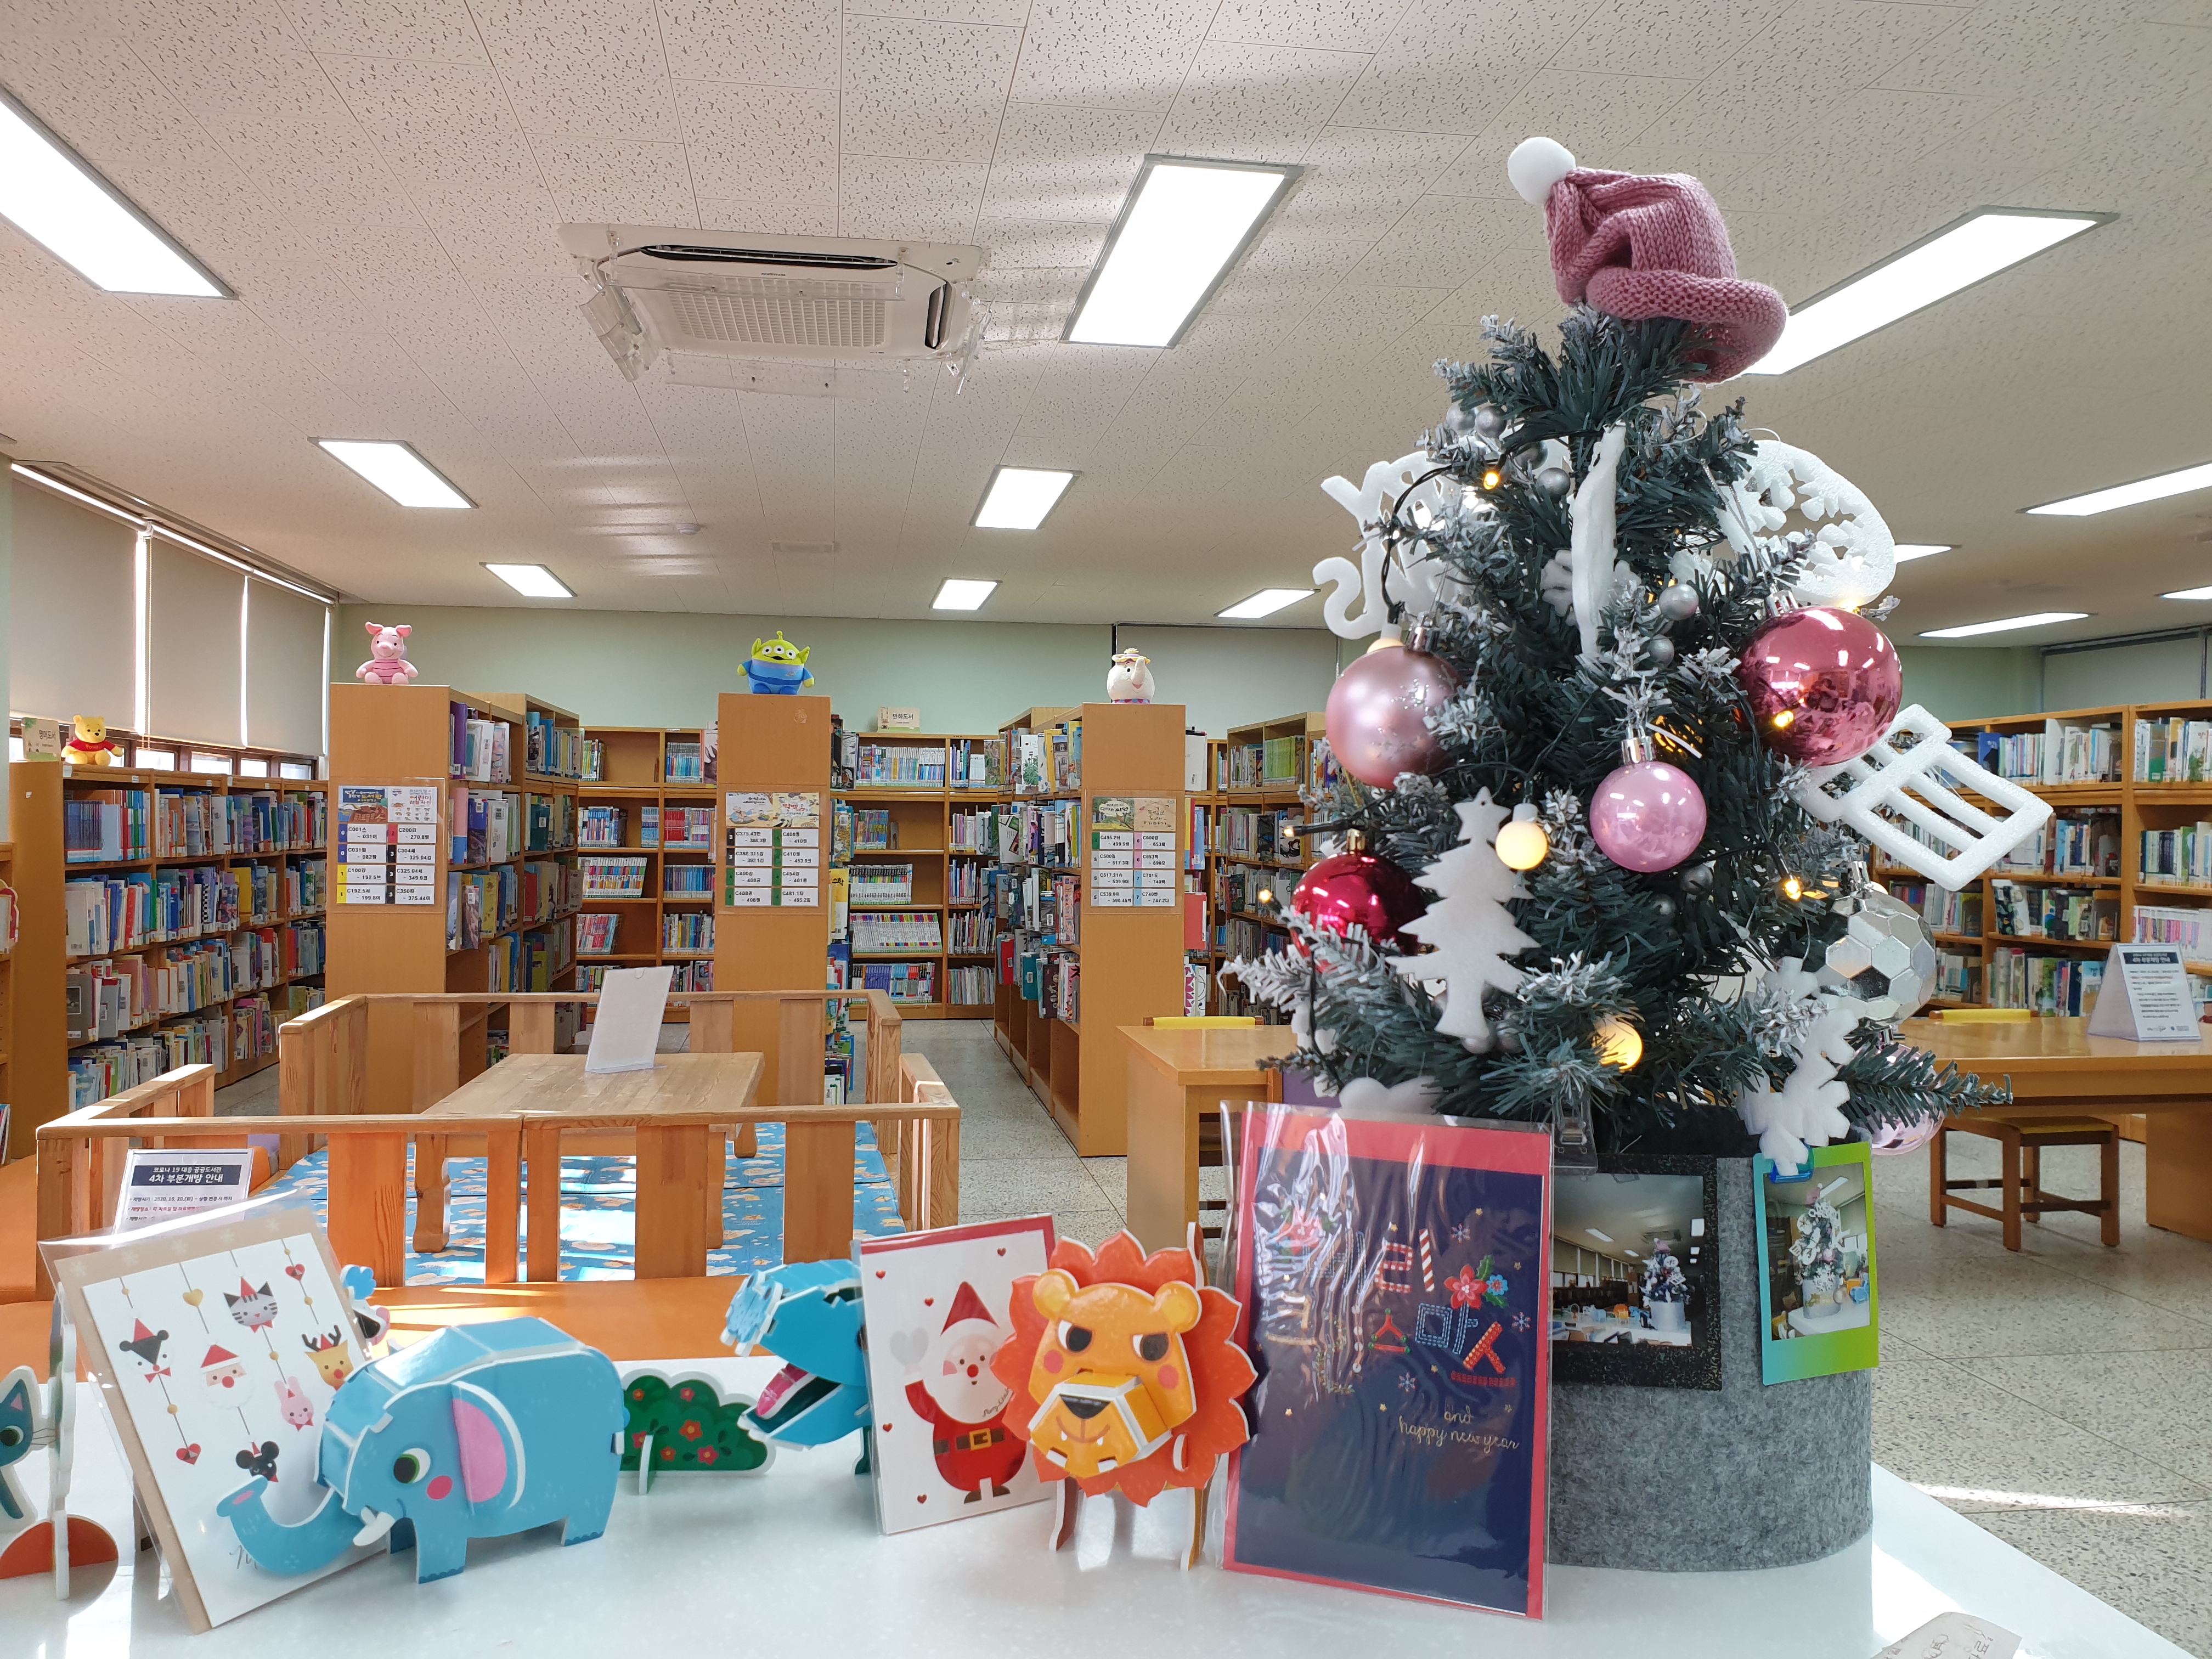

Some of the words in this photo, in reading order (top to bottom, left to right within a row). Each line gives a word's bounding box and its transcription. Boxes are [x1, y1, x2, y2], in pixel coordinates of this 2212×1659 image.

[149, 1174, 165, 1183] 4차
[167, 1174, 202, 1183] 부분개방
[206, 1174, 223, 1183] 안내
[1444, 1405, 1474, 1425] and
[1398, 1415, 1448, 1447] happy
[1451, 1430, 1481, 1445] new
[1483, 1435, 1520, 1454] year
